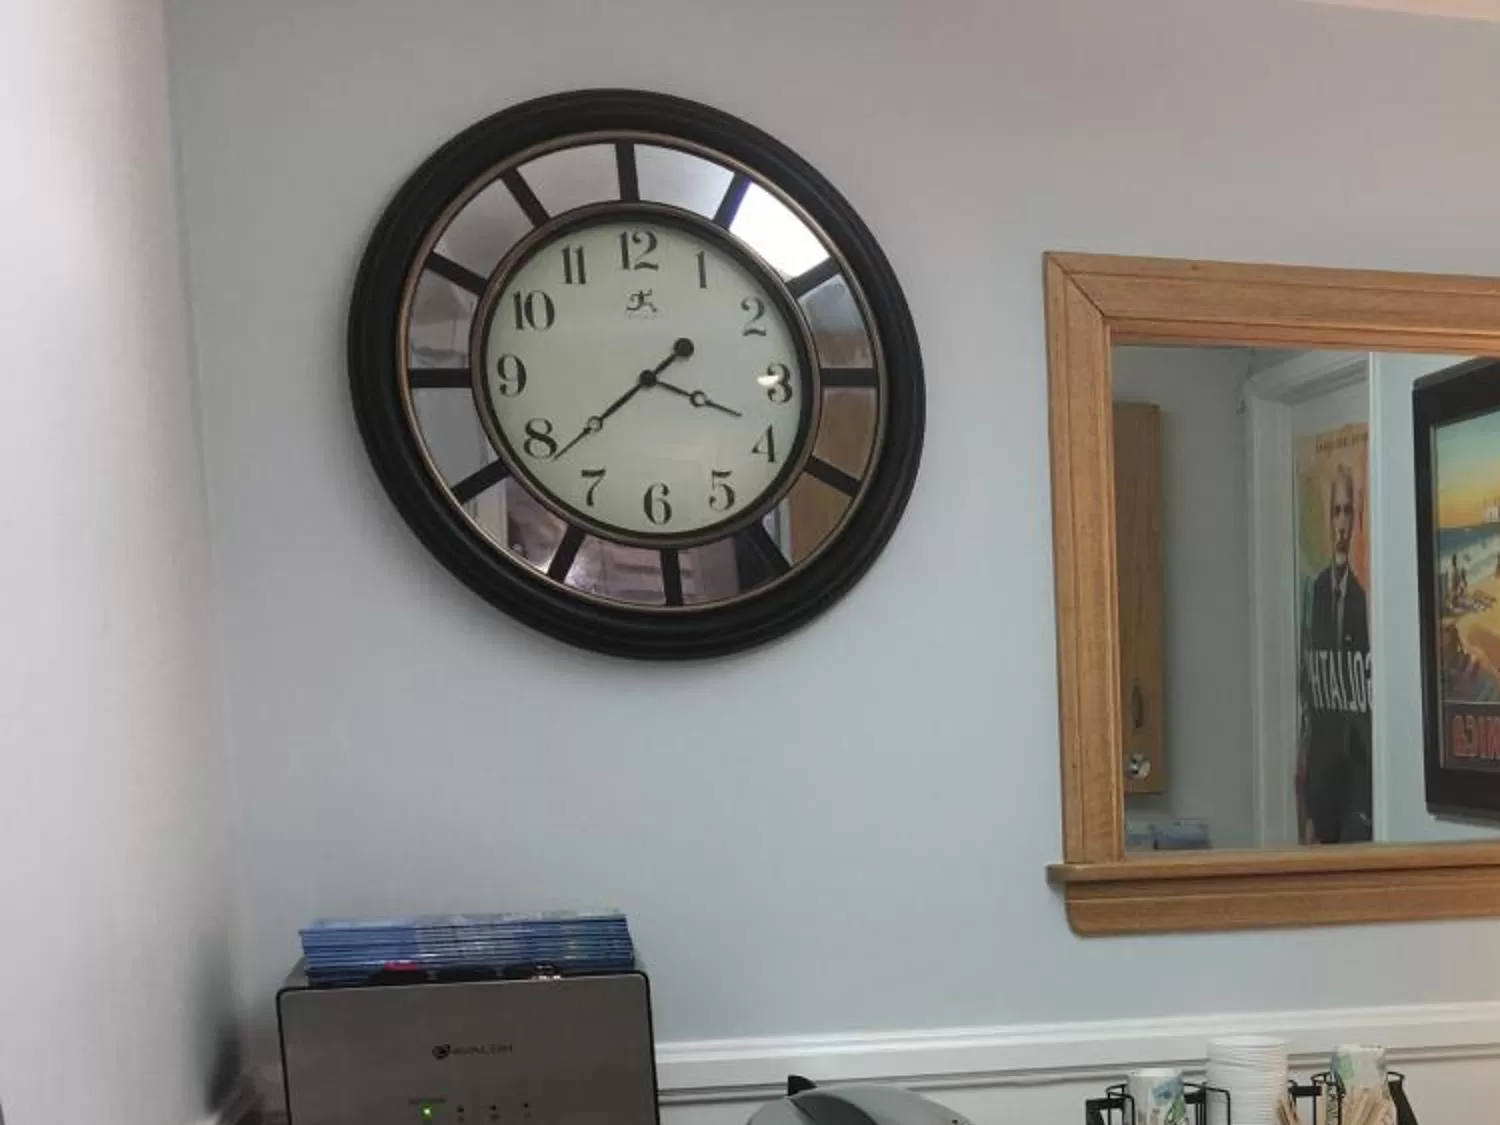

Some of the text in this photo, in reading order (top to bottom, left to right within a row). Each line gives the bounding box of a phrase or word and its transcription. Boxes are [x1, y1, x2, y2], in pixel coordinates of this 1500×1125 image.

[560, 244, 587, 285] 11
[619, 229, 660, 271] 12
[694, 250, 709, 290] 1
[512, 290, 556, 331] 10
[740, 296, 768, 337] 2
[495, 353, 527, 396] 9
[765, 362, 793, 404] 3
[522, 417, 558, 459] 8
[751, 424, 777, 463] 4
[580, 468, 607, 507] 7
[642, 483, 672, 525] 6
[707, 470, 736, 511] 5
